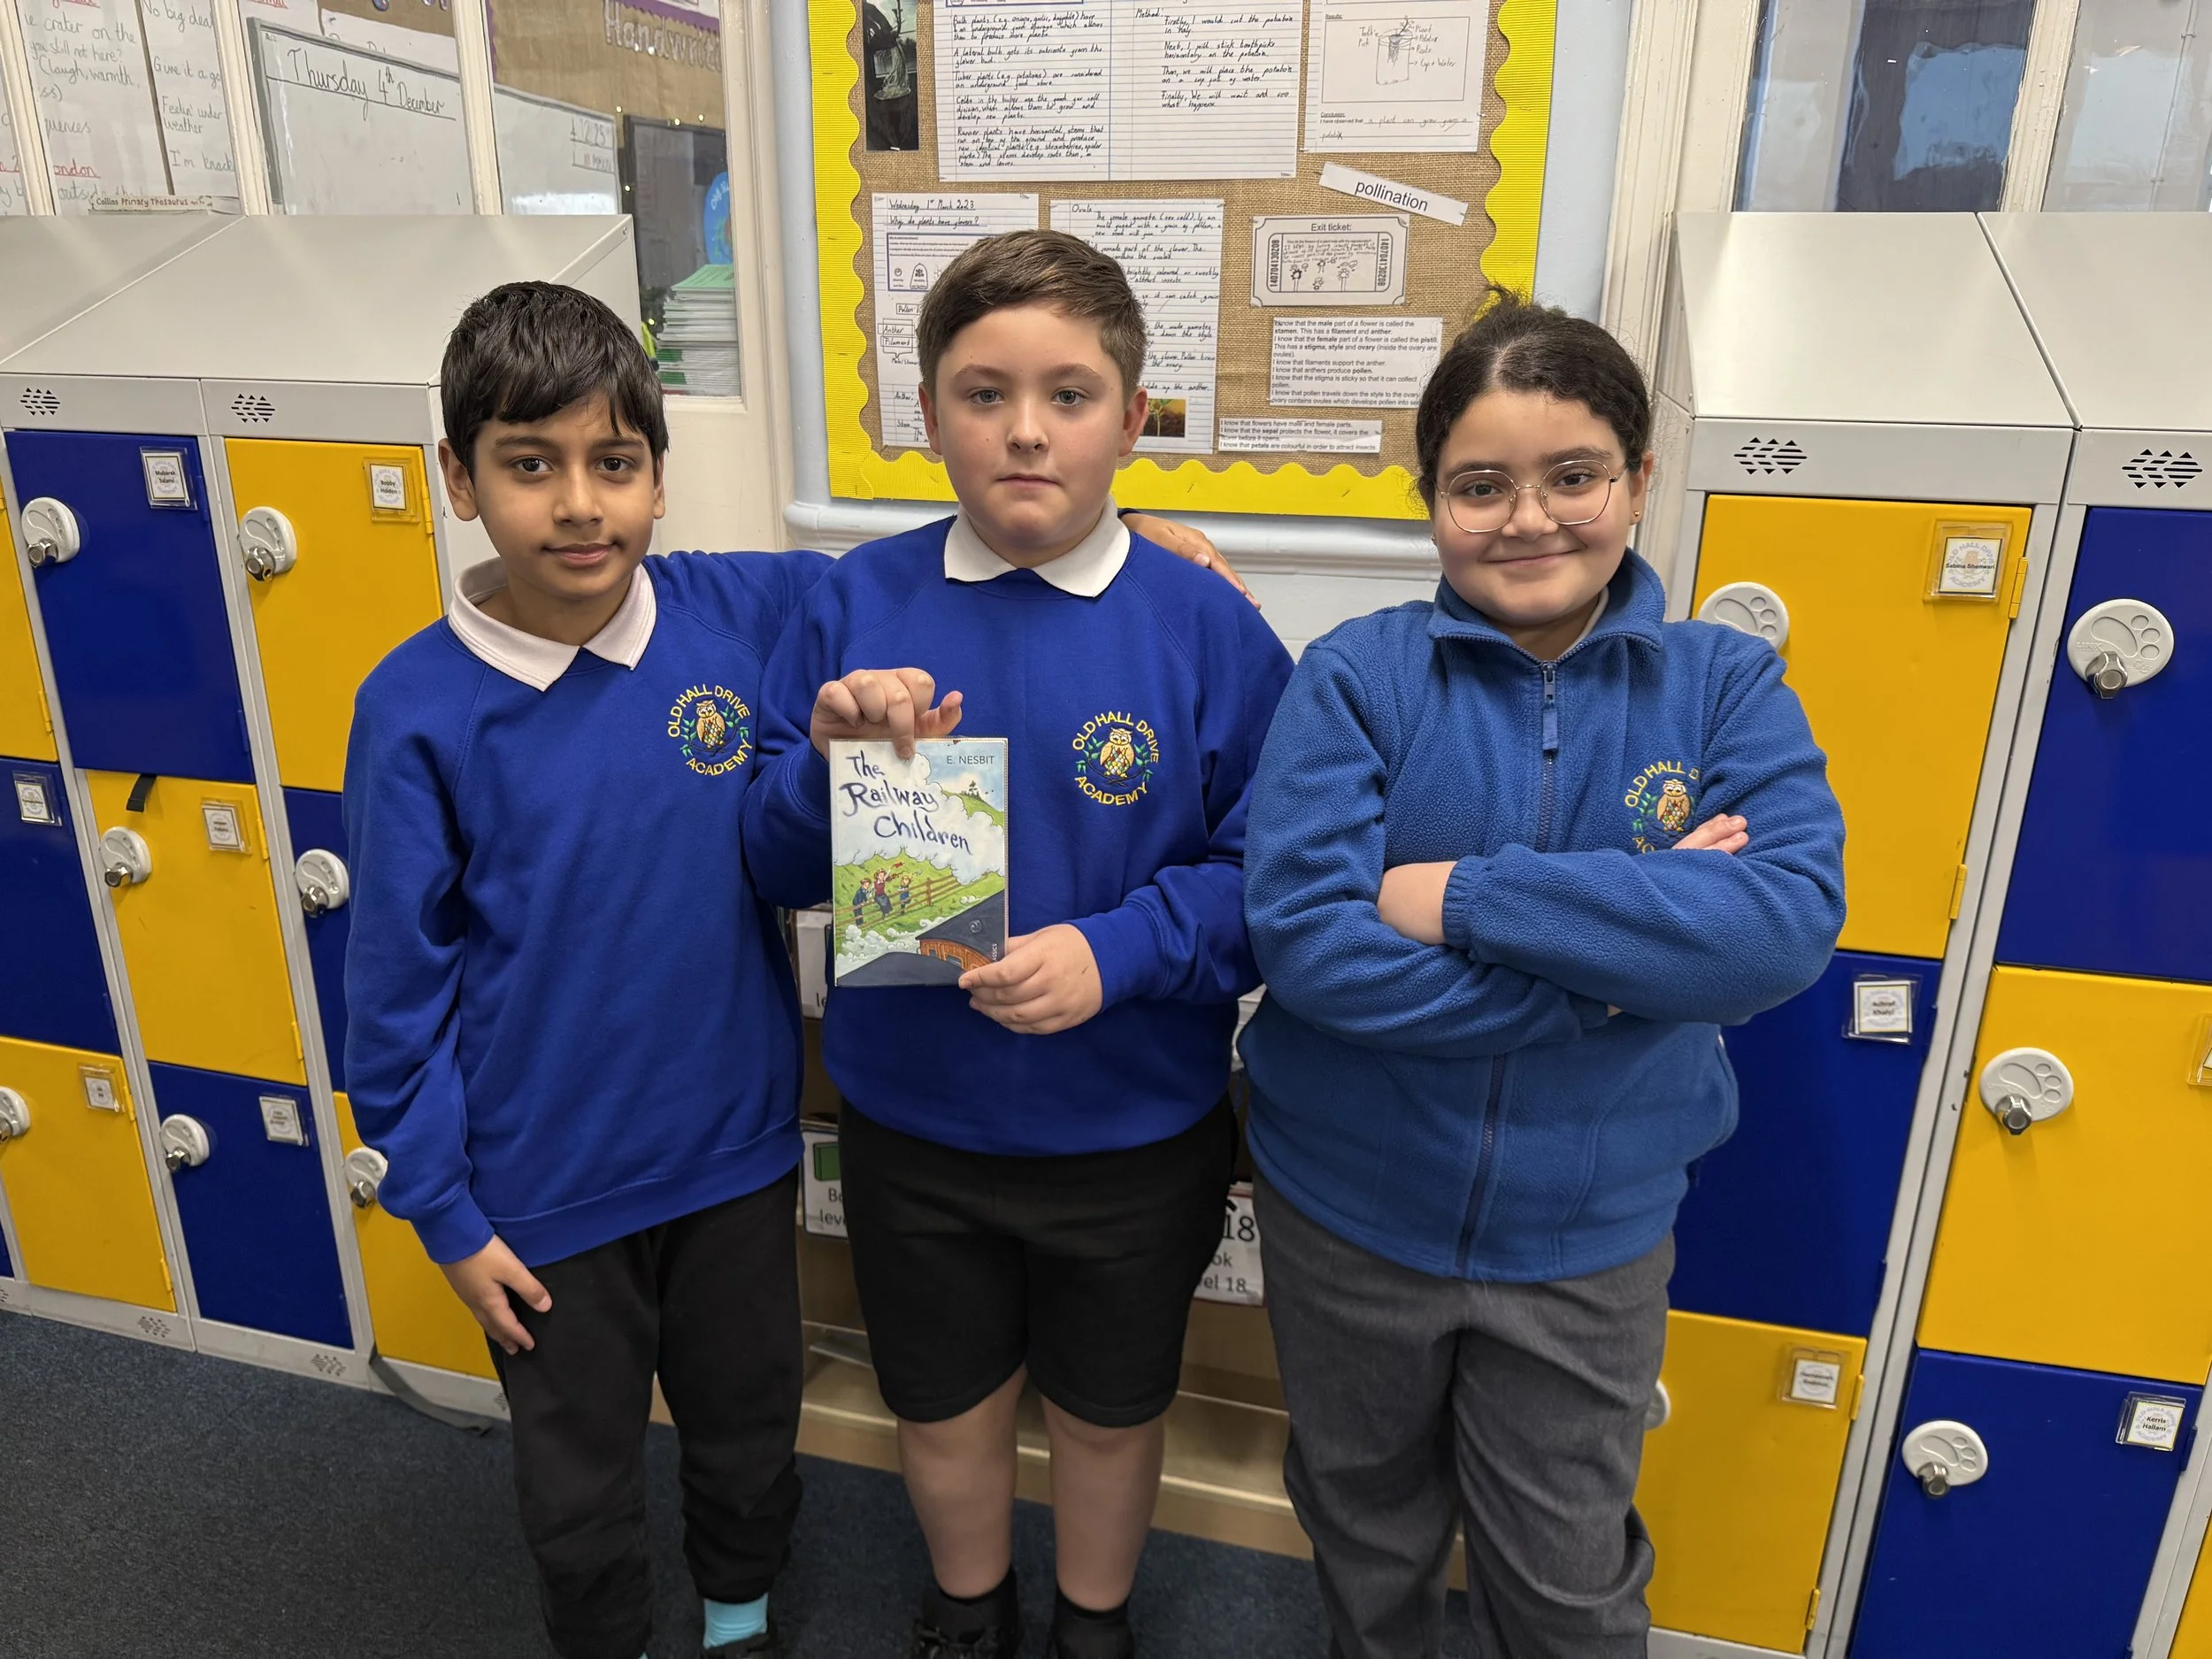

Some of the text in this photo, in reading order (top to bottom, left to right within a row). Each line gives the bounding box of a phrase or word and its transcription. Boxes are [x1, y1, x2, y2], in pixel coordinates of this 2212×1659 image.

[44, 12, 82, 34] crater
[92, 28, 111, 41] on
[115, 22, 136, 44] the
[166, 2, 185, 33] big
[1248, 14, 1258, 23] the
[50, 38, 70, 54] still
[73, 45, 88, 58] not
[92, 46, 122, 63] here?
[183, 60, 194, 78] it
[198, 69, 207, 80] a
[1240, 65, 1254, 73] the
[287, 48, 445, 120] Thursday 4th December
[163, 117, 203, 134] weather
[197, 103, 222, 120] under
[170, 150, 234, 173] I'm knack
[889, 199, 919, 213] Wednesday
[937, 199, 953, 210] March
[1355, 181, 1428, 211] pollination
[668, 684, 750, 737] OLD HALL DRIVE
[1072, 711, 1159, 764] OLD HALL DRIVE
[686, 739, 752, 775] ACADEMY
[846, 749, 885, 780] The
[947, 755, 995, 764] E. NESBIT
[1075, 776, 1147, 805] ACADEMY
[1624, 761, 1686, 807] OLD HALL
[839, 780, 939, 818] Railway
[874, 810, 973, 856] Children
[1224, 1214, 1255, 1242] 18
[1226, 1277, 1247, 1293] 18
